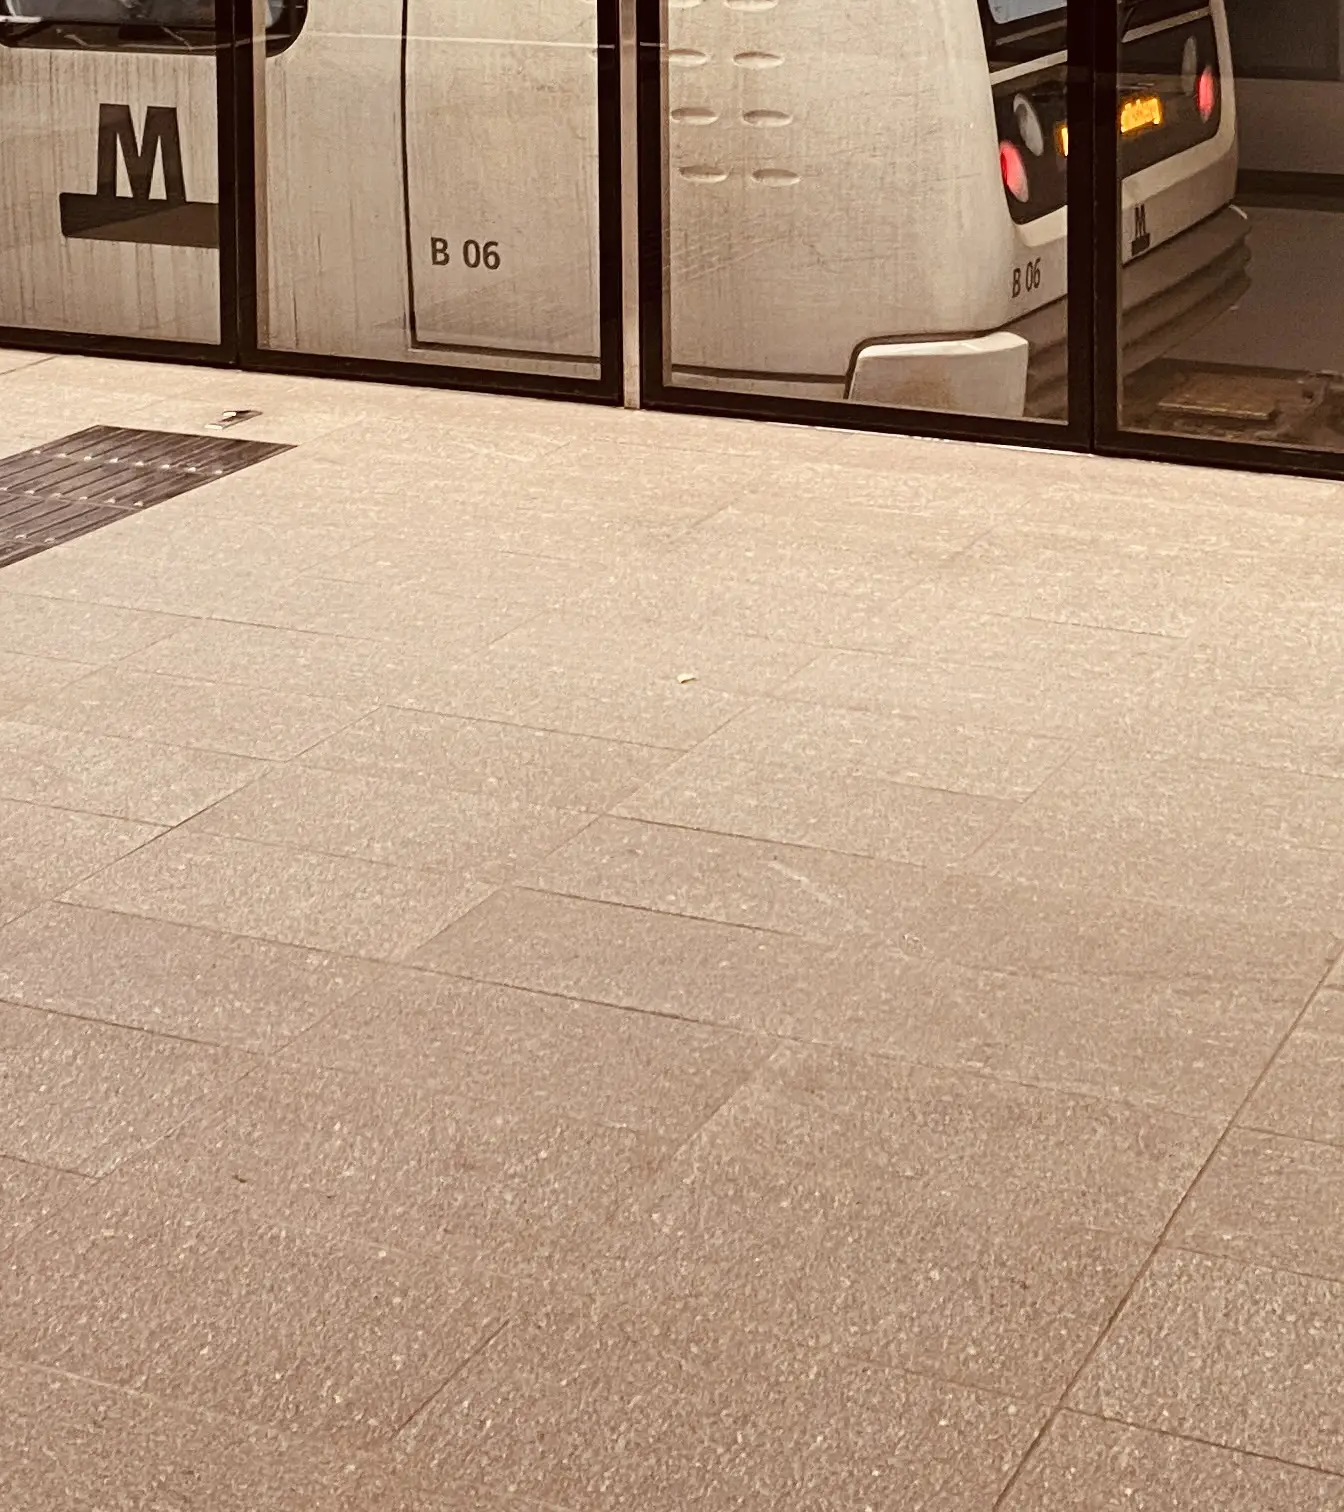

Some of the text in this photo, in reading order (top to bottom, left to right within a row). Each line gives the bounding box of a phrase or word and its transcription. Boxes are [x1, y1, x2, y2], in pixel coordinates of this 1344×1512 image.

[96, 103, 188, 201] M
[430, 236, 501, 270] B 06
[1011, 256, 1042, 298] B 06
